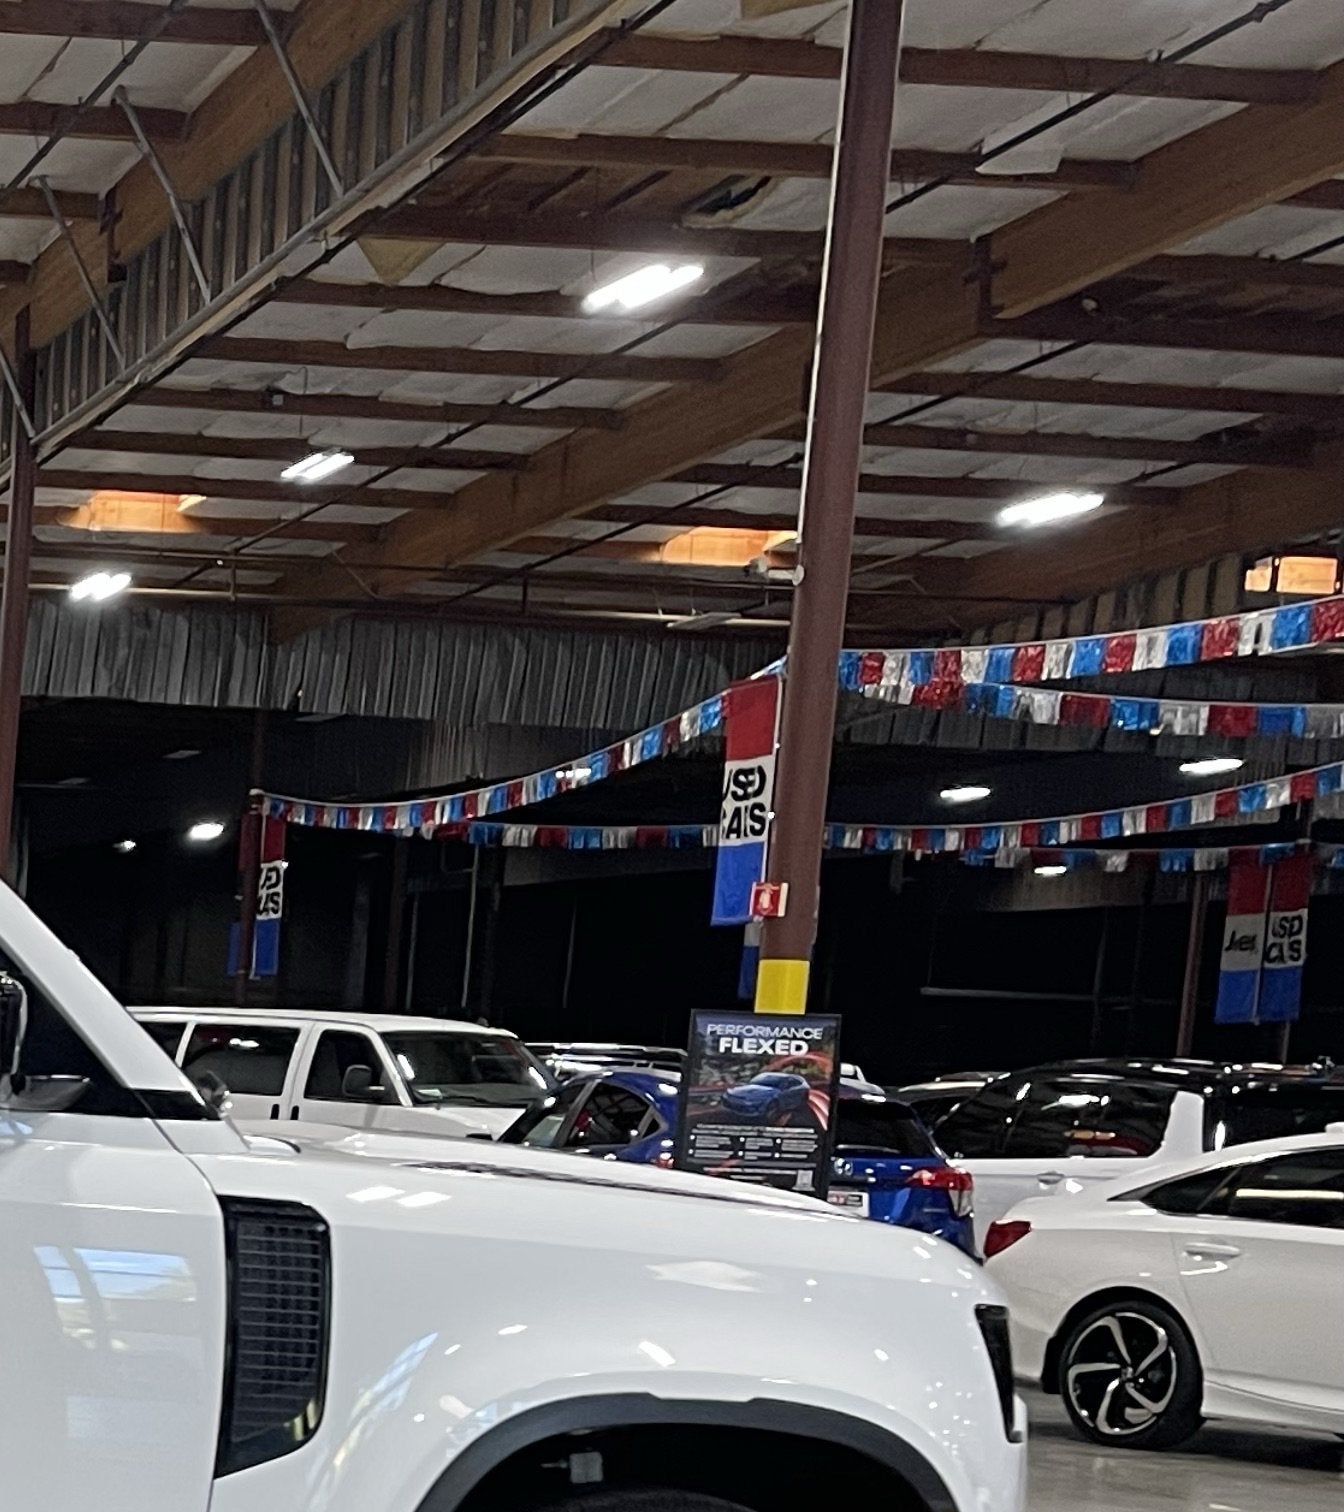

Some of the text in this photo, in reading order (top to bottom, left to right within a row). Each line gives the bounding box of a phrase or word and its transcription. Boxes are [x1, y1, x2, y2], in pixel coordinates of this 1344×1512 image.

[722, 802, 766, 839] AS
[706, 1023, 824, 1040] PERFORMANCE
[719, 1037, 810, 1056] FLEXED
